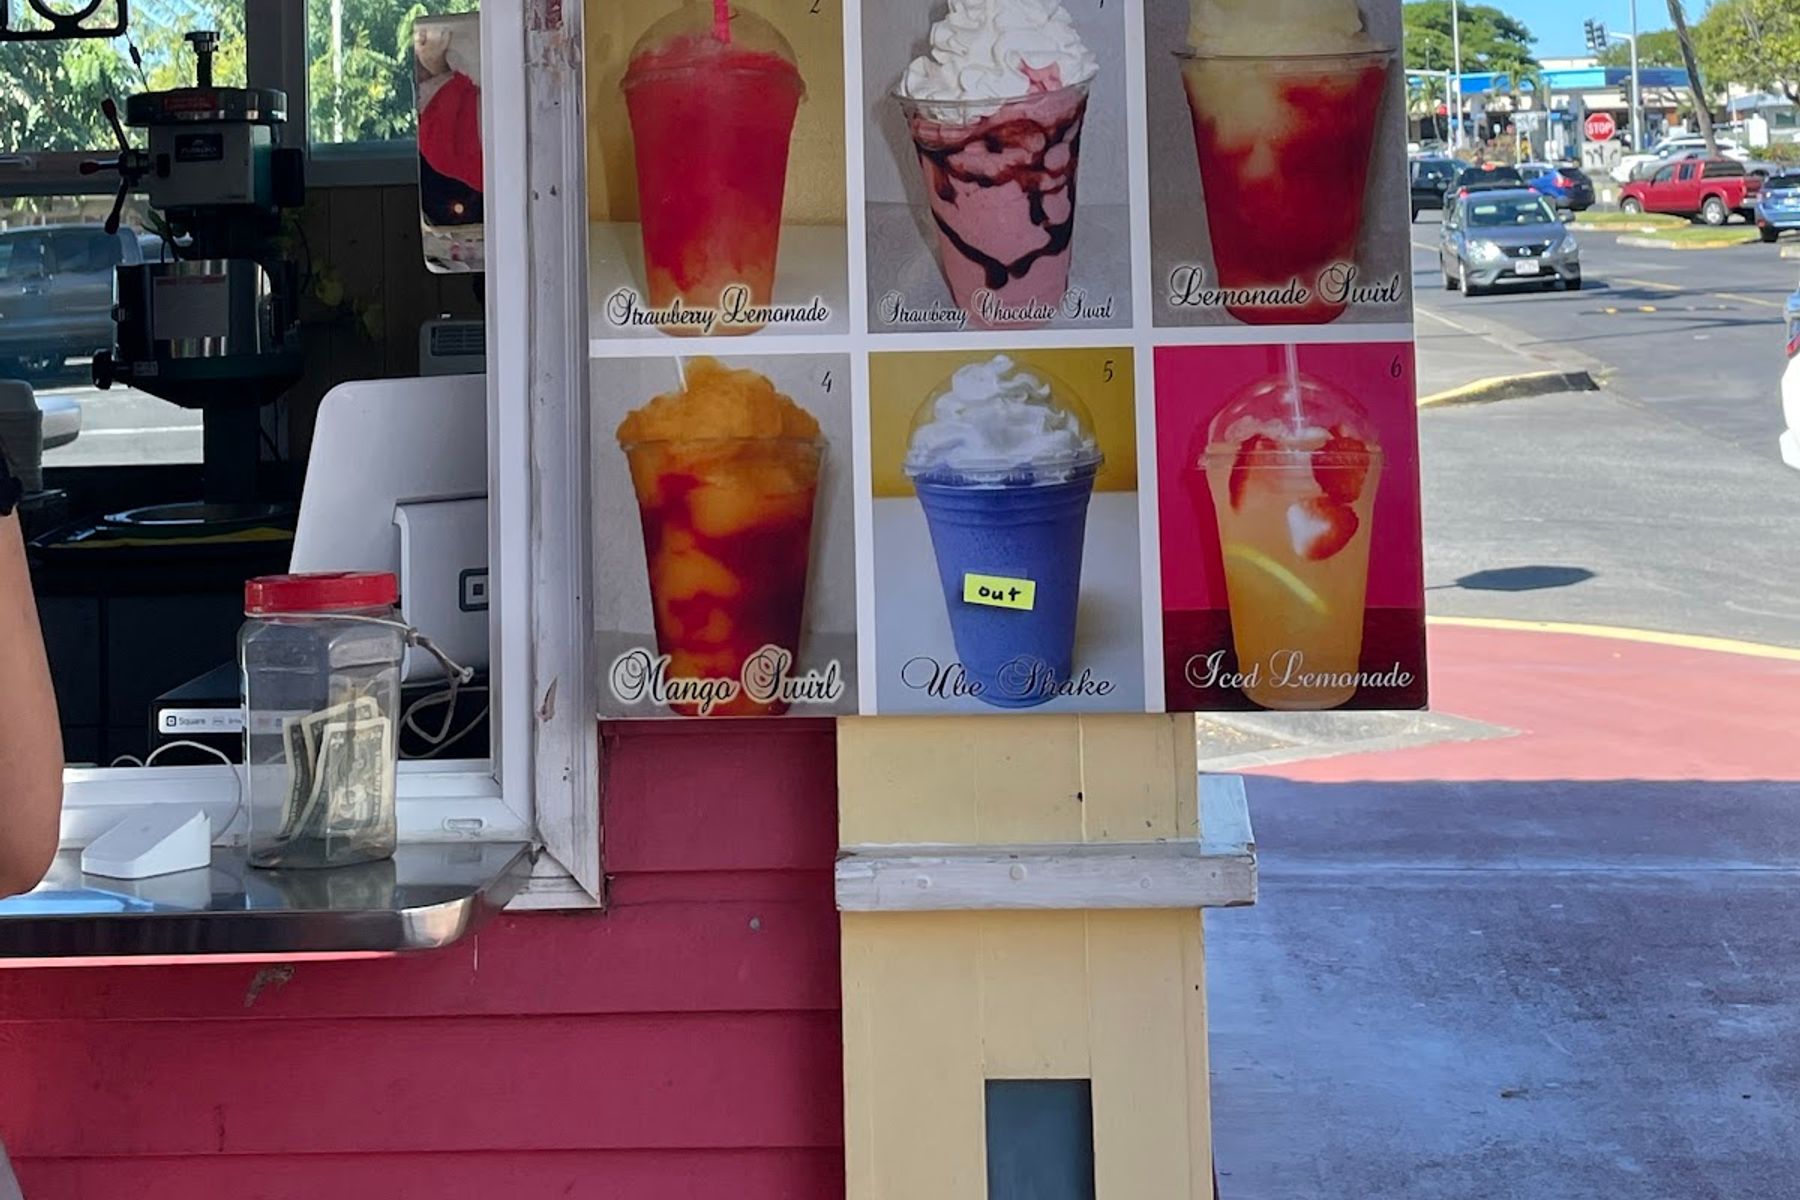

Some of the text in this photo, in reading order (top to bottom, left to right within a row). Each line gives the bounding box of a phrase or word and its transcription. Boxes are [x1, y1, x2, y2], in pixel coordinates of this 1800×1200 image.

[1588, 122, 1612, 135] STOP
[1170, 262, 1402, 306] Lemonade Swirl
[607, 286, 829, 332] Strawberry Lemonade
[881, 287, 1114, 329] Strawberry Chocolate Swirl
[821, 370, 833, 393] 4
[1103, 361, 1113, 383] 5
[1391, 355, 1402, 379] 6
[978, 586, 1021, 601] out
[613, 648, 841, 713] Mango Swirl
[901, 655, 1116, 699] Ube Shake
[1185, 650, 1414, 689] Iced Lemonade
[178, 717, 206, 726] Square
